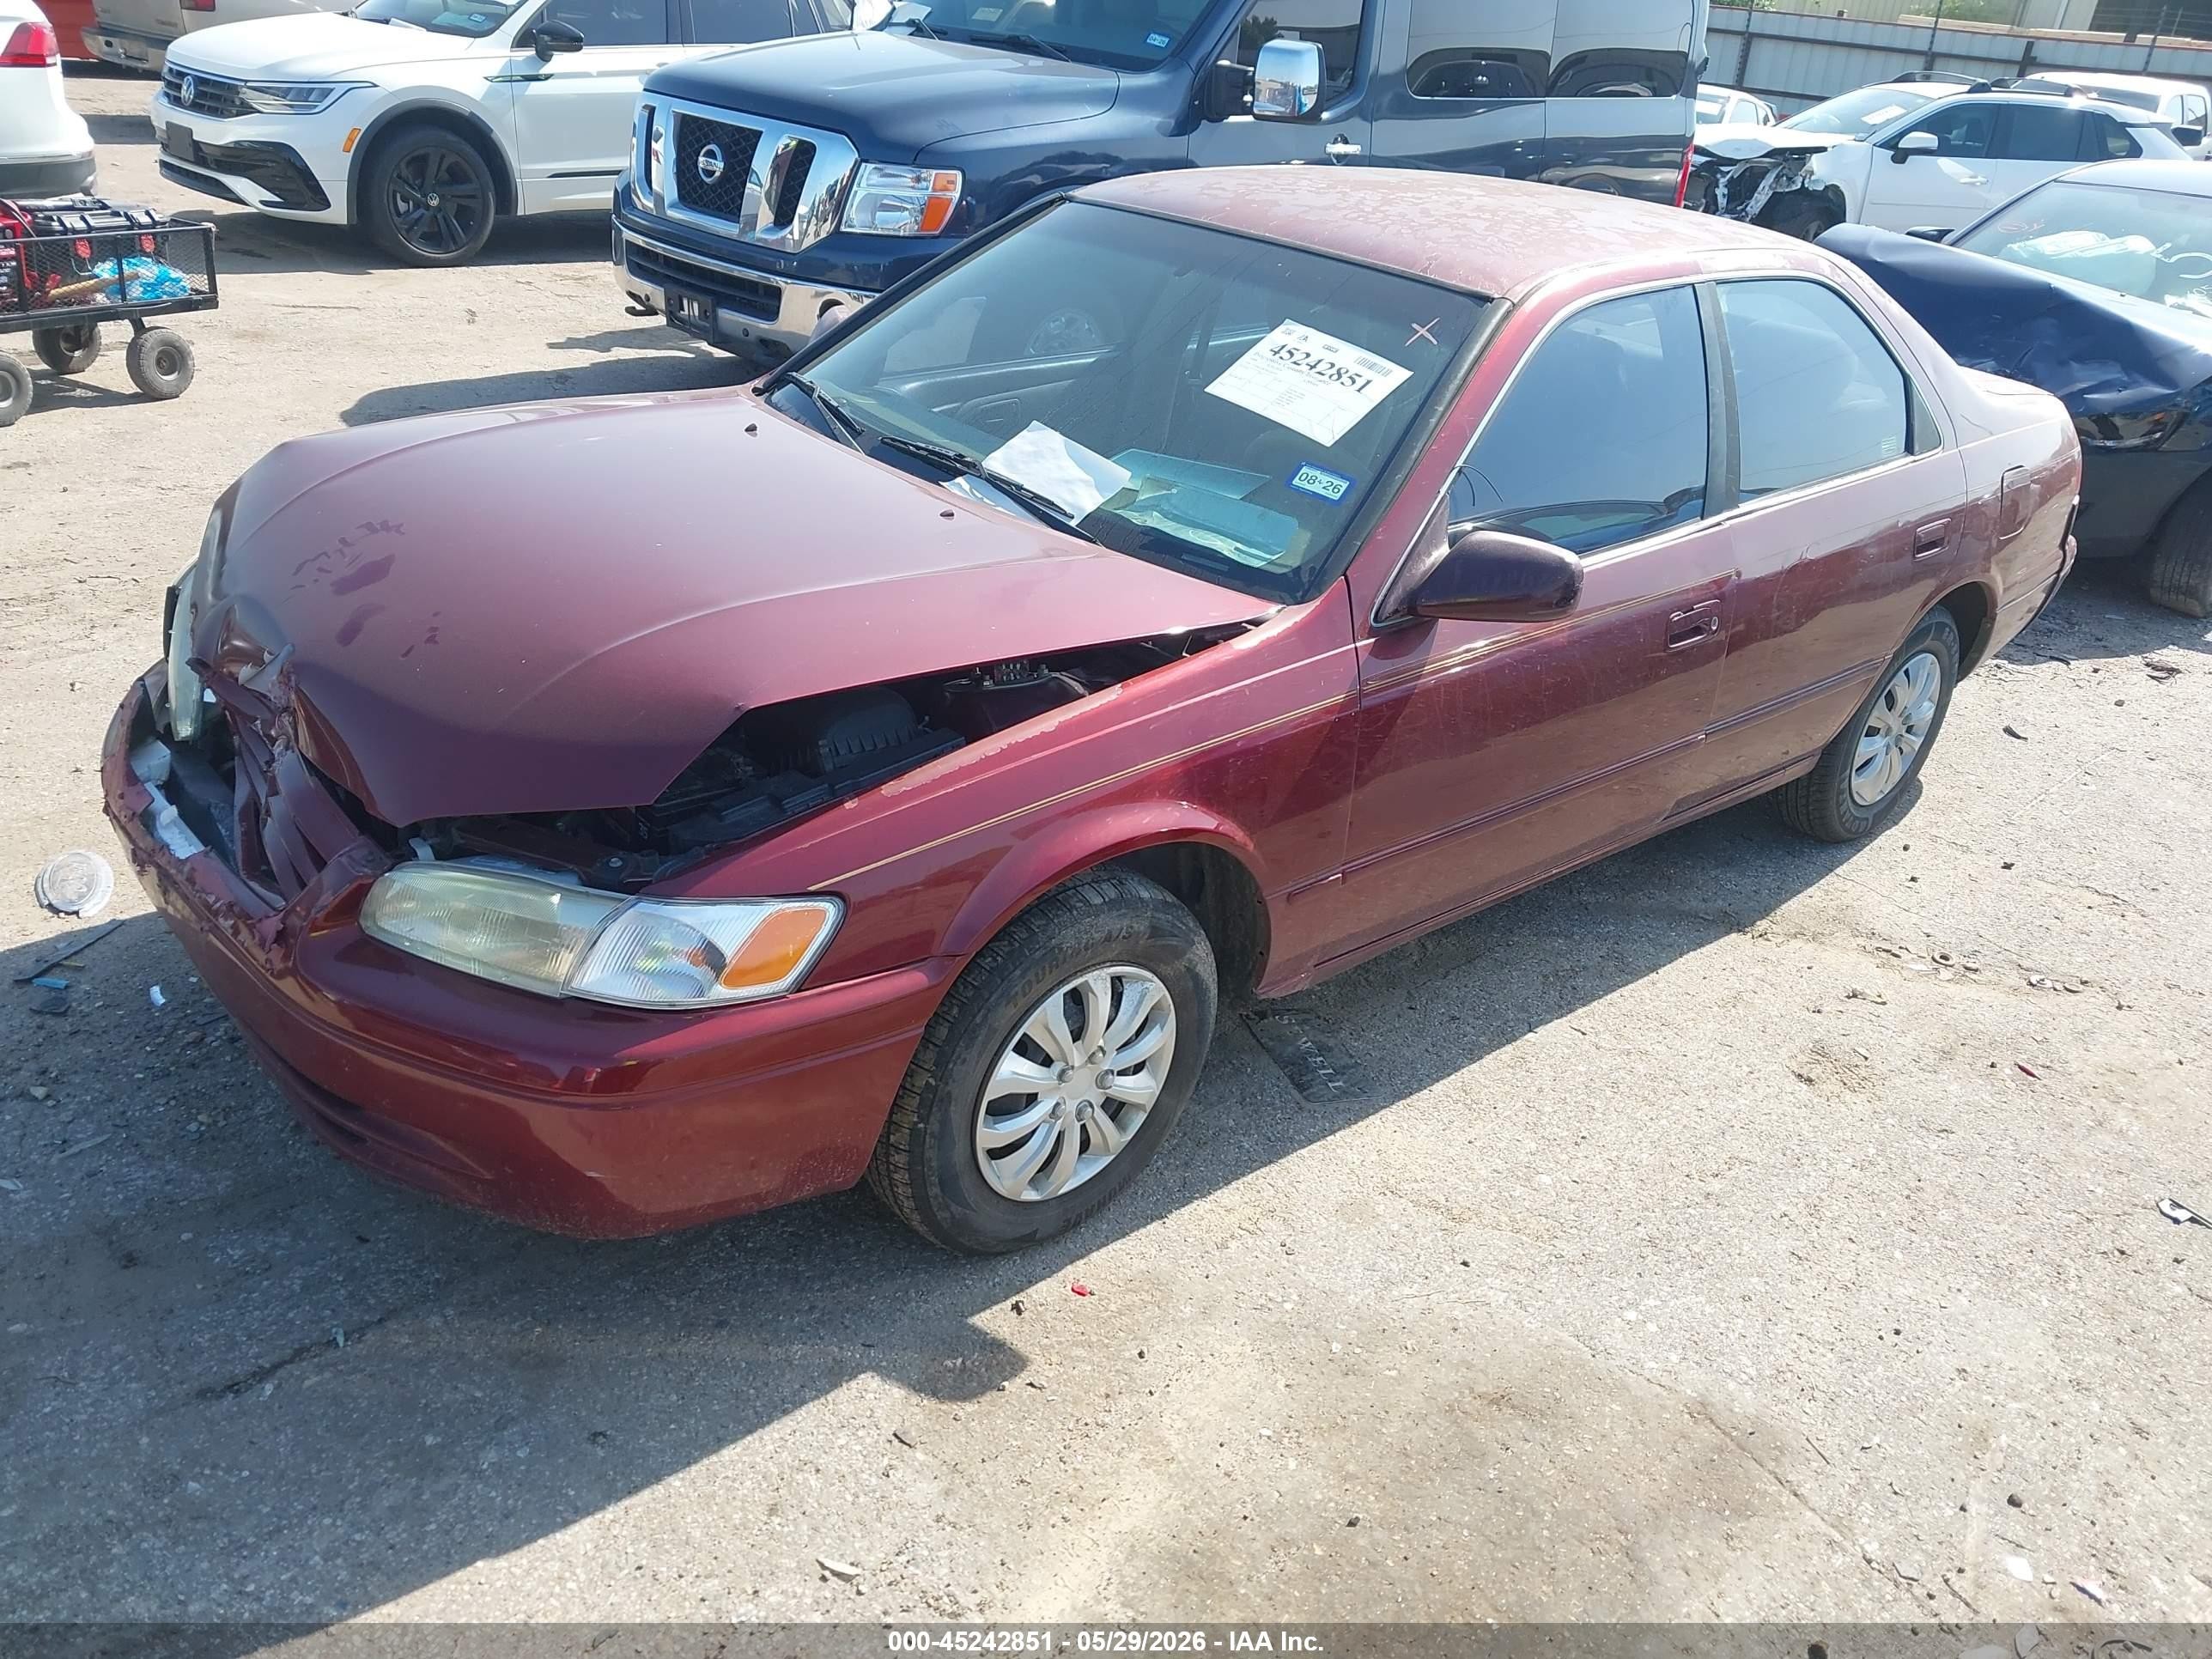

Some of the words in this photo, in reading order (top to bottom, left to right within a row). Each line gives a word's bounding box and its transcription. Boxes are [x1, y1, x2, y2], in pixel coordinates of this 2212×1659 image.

[1269, 343, 1373, 393] 45242851
[1298, 472, 1318, 485] 08
[1322, 480, 1343, 495] 26
[1275, 1014, 1345, 1093] SWELL
